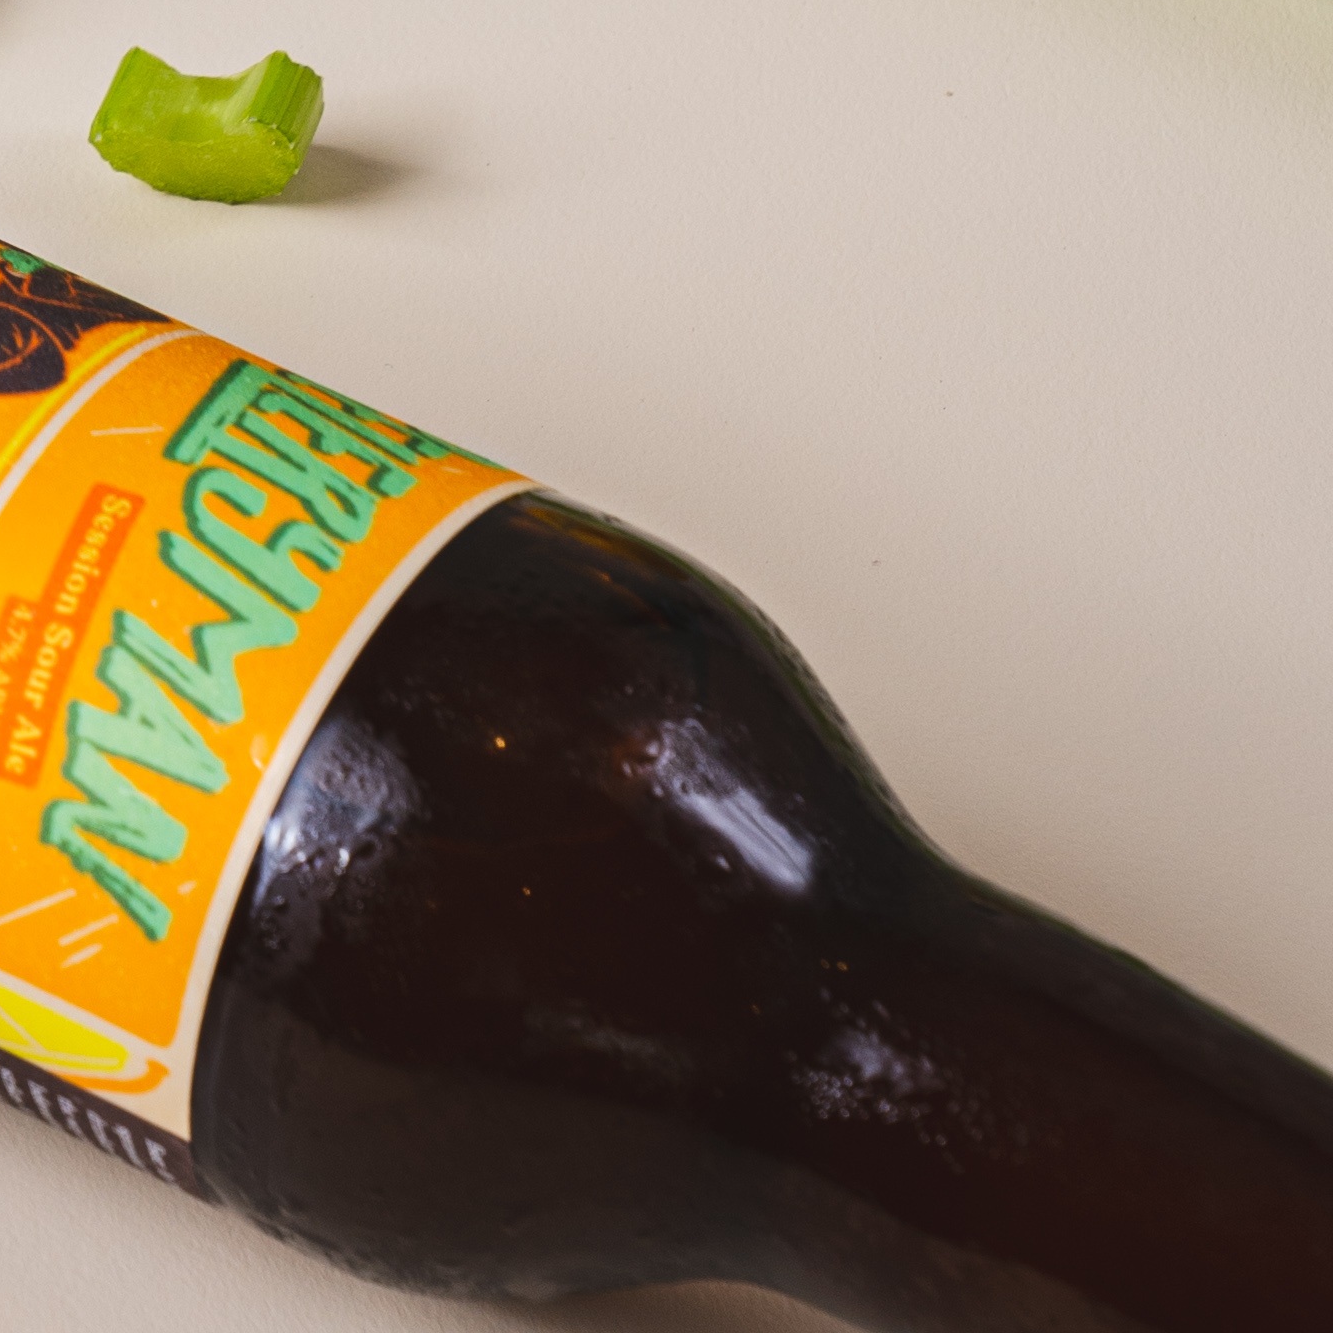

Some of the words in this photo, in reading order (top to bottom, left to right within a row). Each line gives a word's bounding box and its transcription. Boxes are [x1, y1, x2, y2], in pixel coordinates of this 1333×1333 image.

[55, 493, 132, 616] Session
[24, 622, 75, 710] Sour
[39, 358, 503, 941] ELERYMAN
[4, 714, 43, 775] Ale
